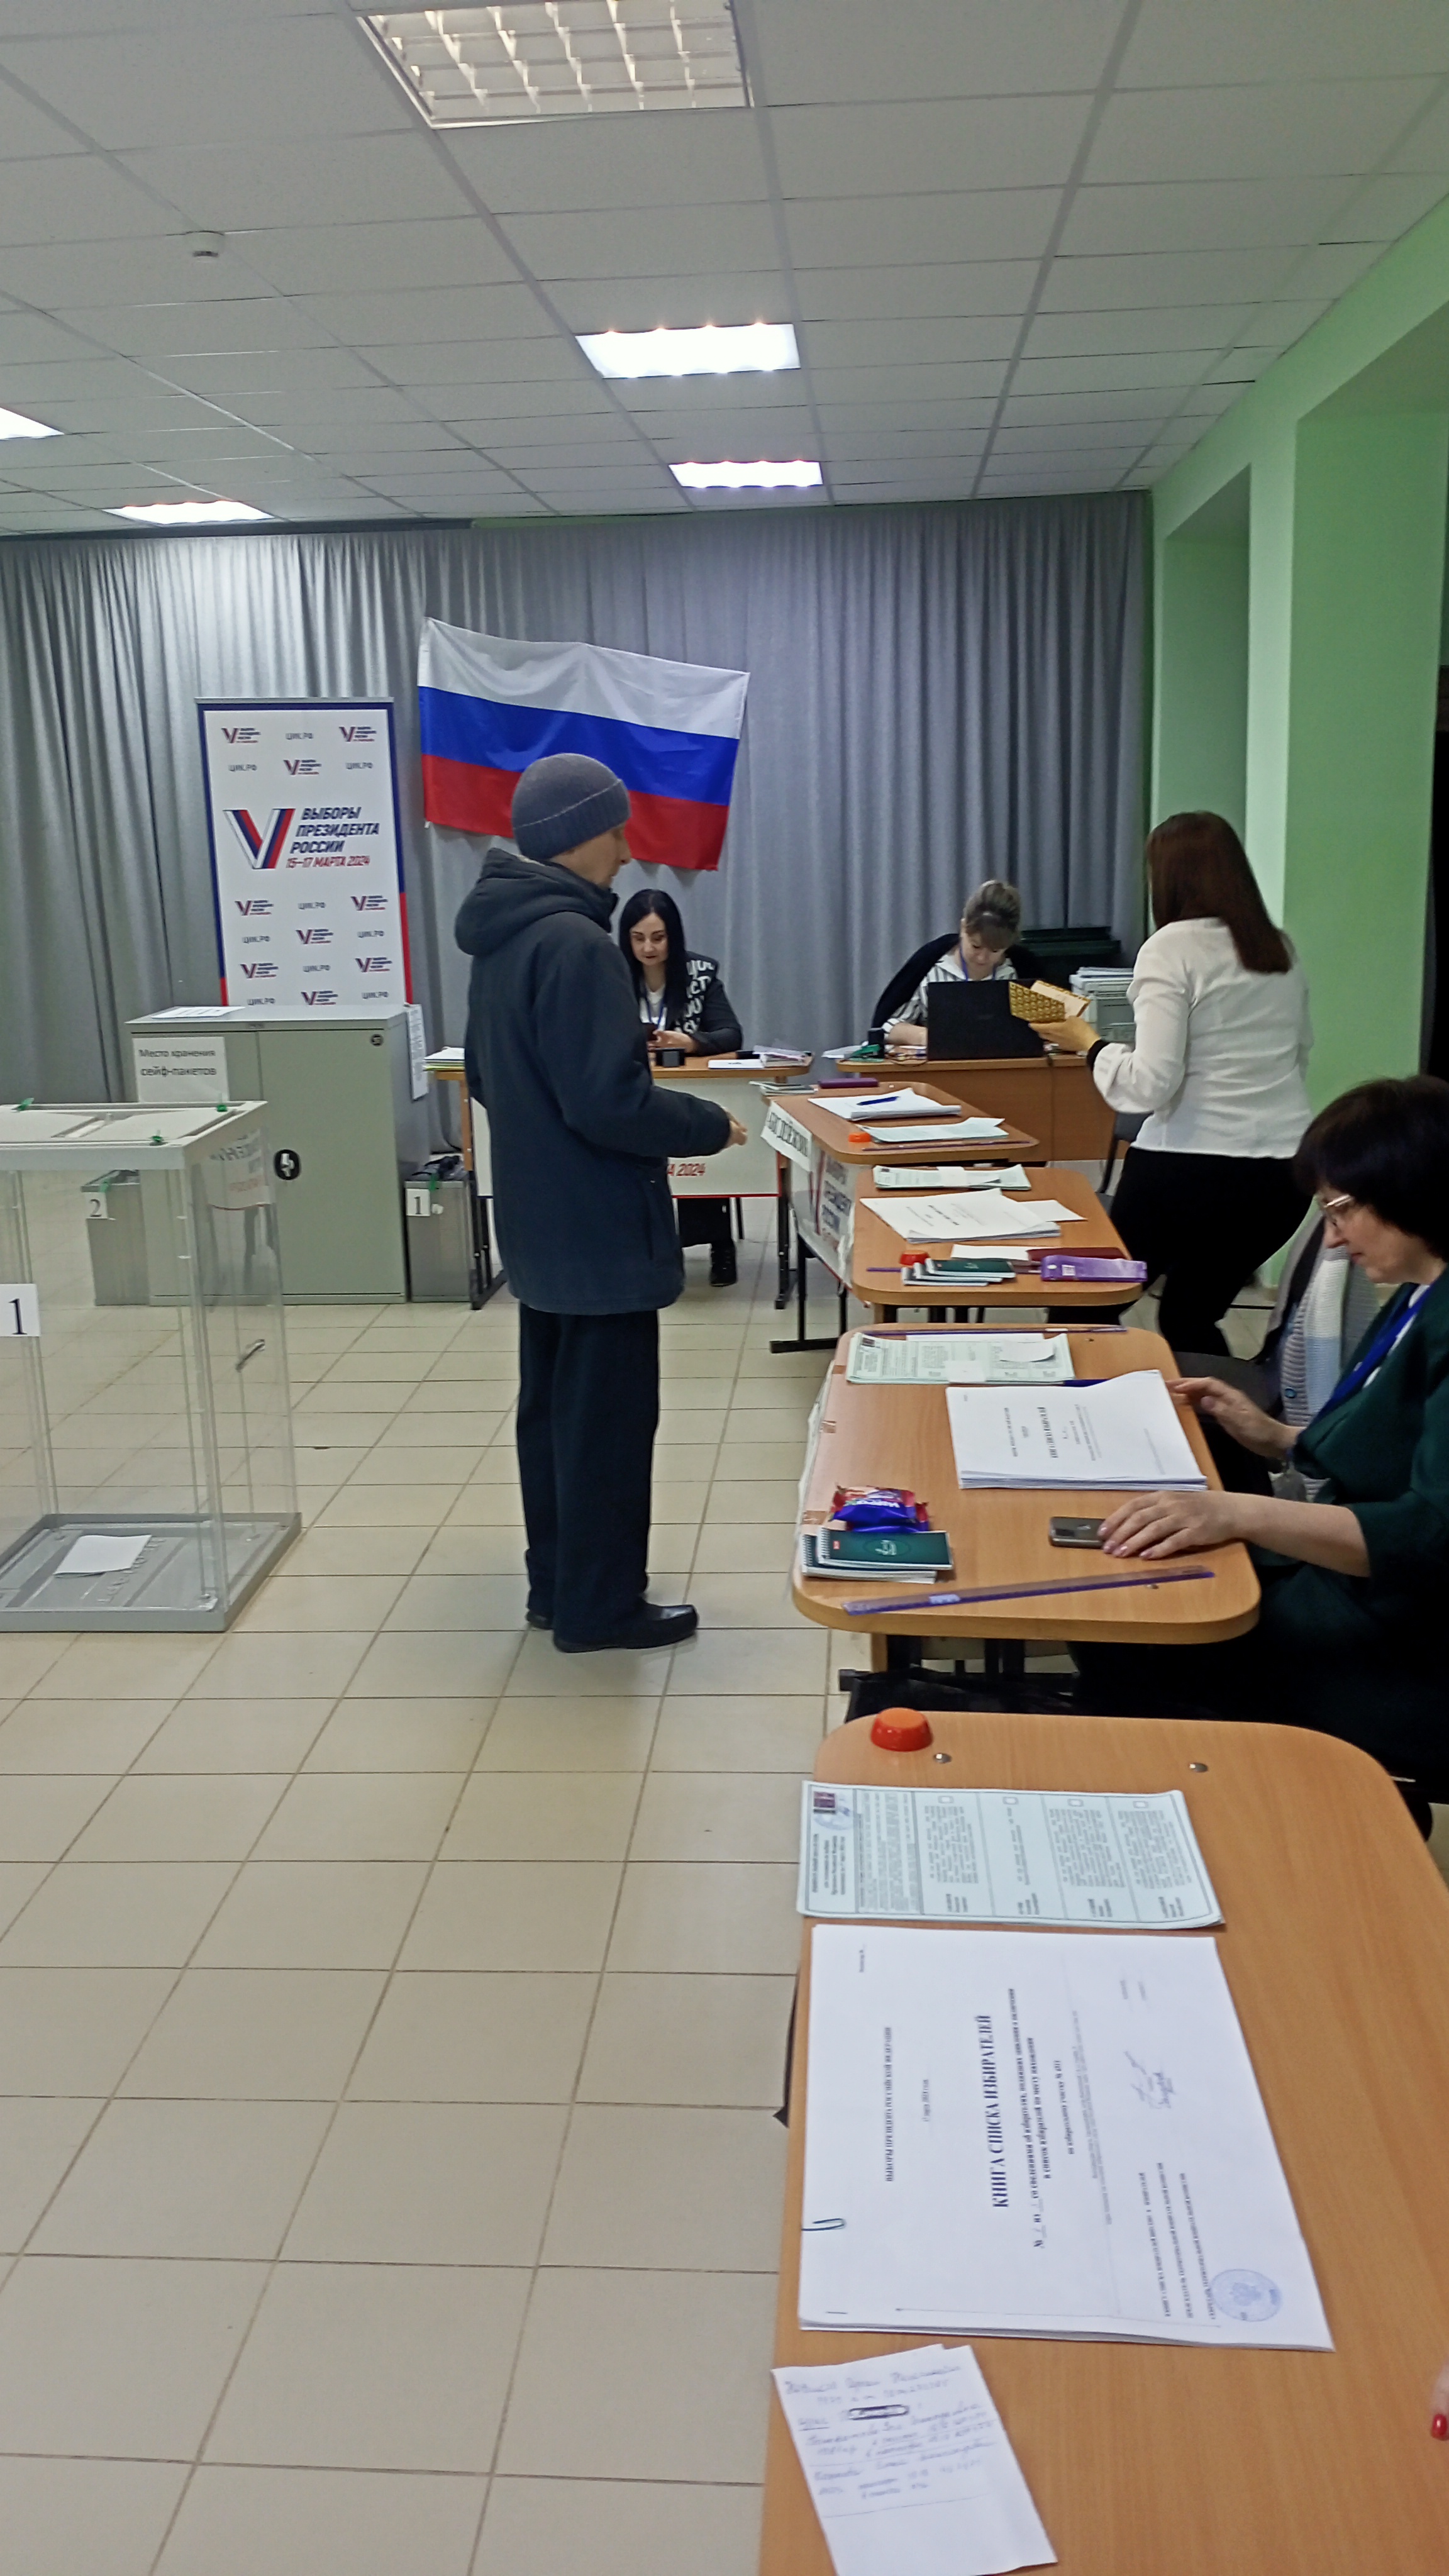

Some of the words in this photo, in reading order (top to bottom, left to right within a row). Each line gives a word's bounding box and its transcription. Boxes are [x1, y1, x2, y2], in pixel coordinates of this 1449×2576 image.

[301, 807, 362, 820] ВЫБОРЫ
[296, 823, 380, 838] ПРЕЗИДЕНТА
[290, 840, 345, 853] РОССИИ
[314, 856, 346, 867] МАРТА
[348, 855, 370, 866] 2024
[138, 1049, 169, 1057] Место
[140, 1066, 216, 1077] сейф-пакетов
[676, 1163, 706, 1176] 2024
[90, 1199, 102, 1217] 2
[414, 1196, 422, 1214] 1
[8, 1298, 28, 1335] 1
[974, 2015, 999, 2099] ИЗБИРАТЕЛЕЙ
[985, 2102, 1004, 2155] СПИСКА
[989, 2158, 1009, 2207] КНИГА
